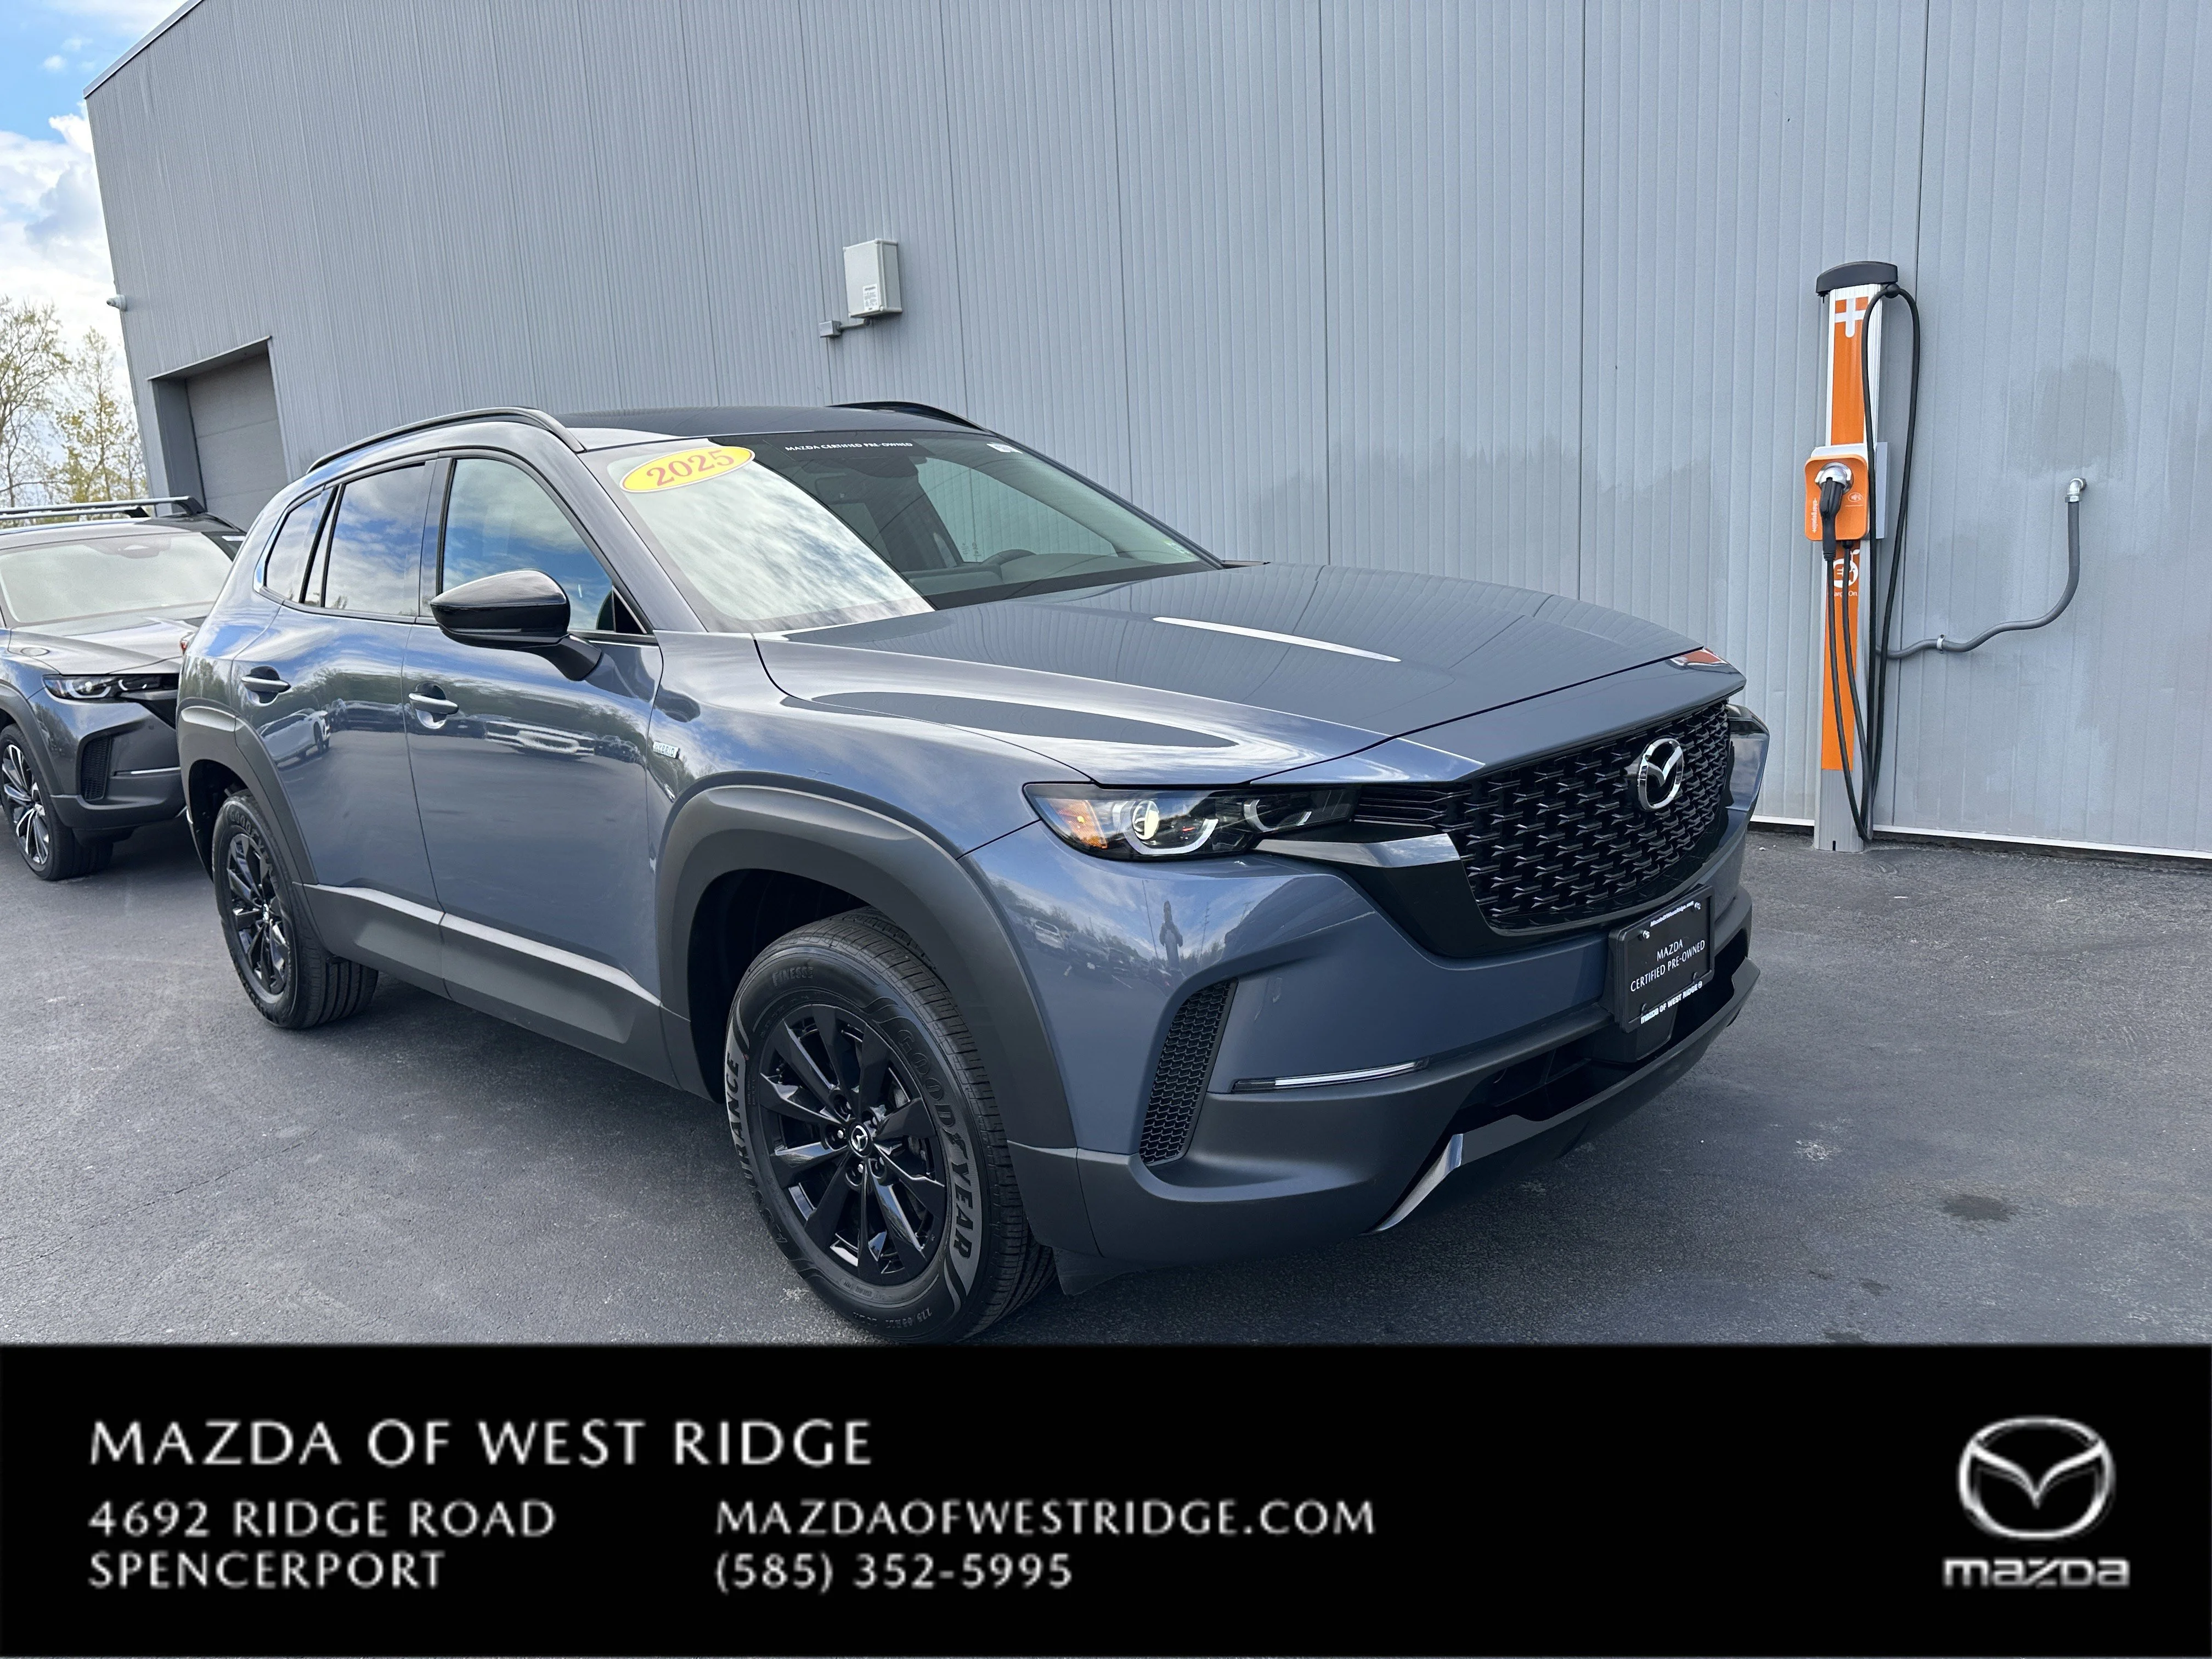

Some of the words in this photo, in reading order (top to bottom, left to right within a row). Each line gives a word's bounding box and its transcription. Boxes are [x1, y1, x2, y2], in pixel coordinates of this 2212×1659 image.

[646, 449, 734, 486] 2025
[654, 744, 675, 757] HYBRID
[1630, 964, 1666, 992] CERTIFIED
[1668, 940, 1705, 972] PRE-OWNED
[1657, 939, 1683, 962] MAZDA
[1660, 1002, 1667, 1013] OF
[1668, 994, 1682, 1008] WEST
[1683, 984, 1698, 998] RIDGE
[727, 1051, 787, 1244] ASSURANCE
[898, 1029, 974, 1260] GOODYEAR
